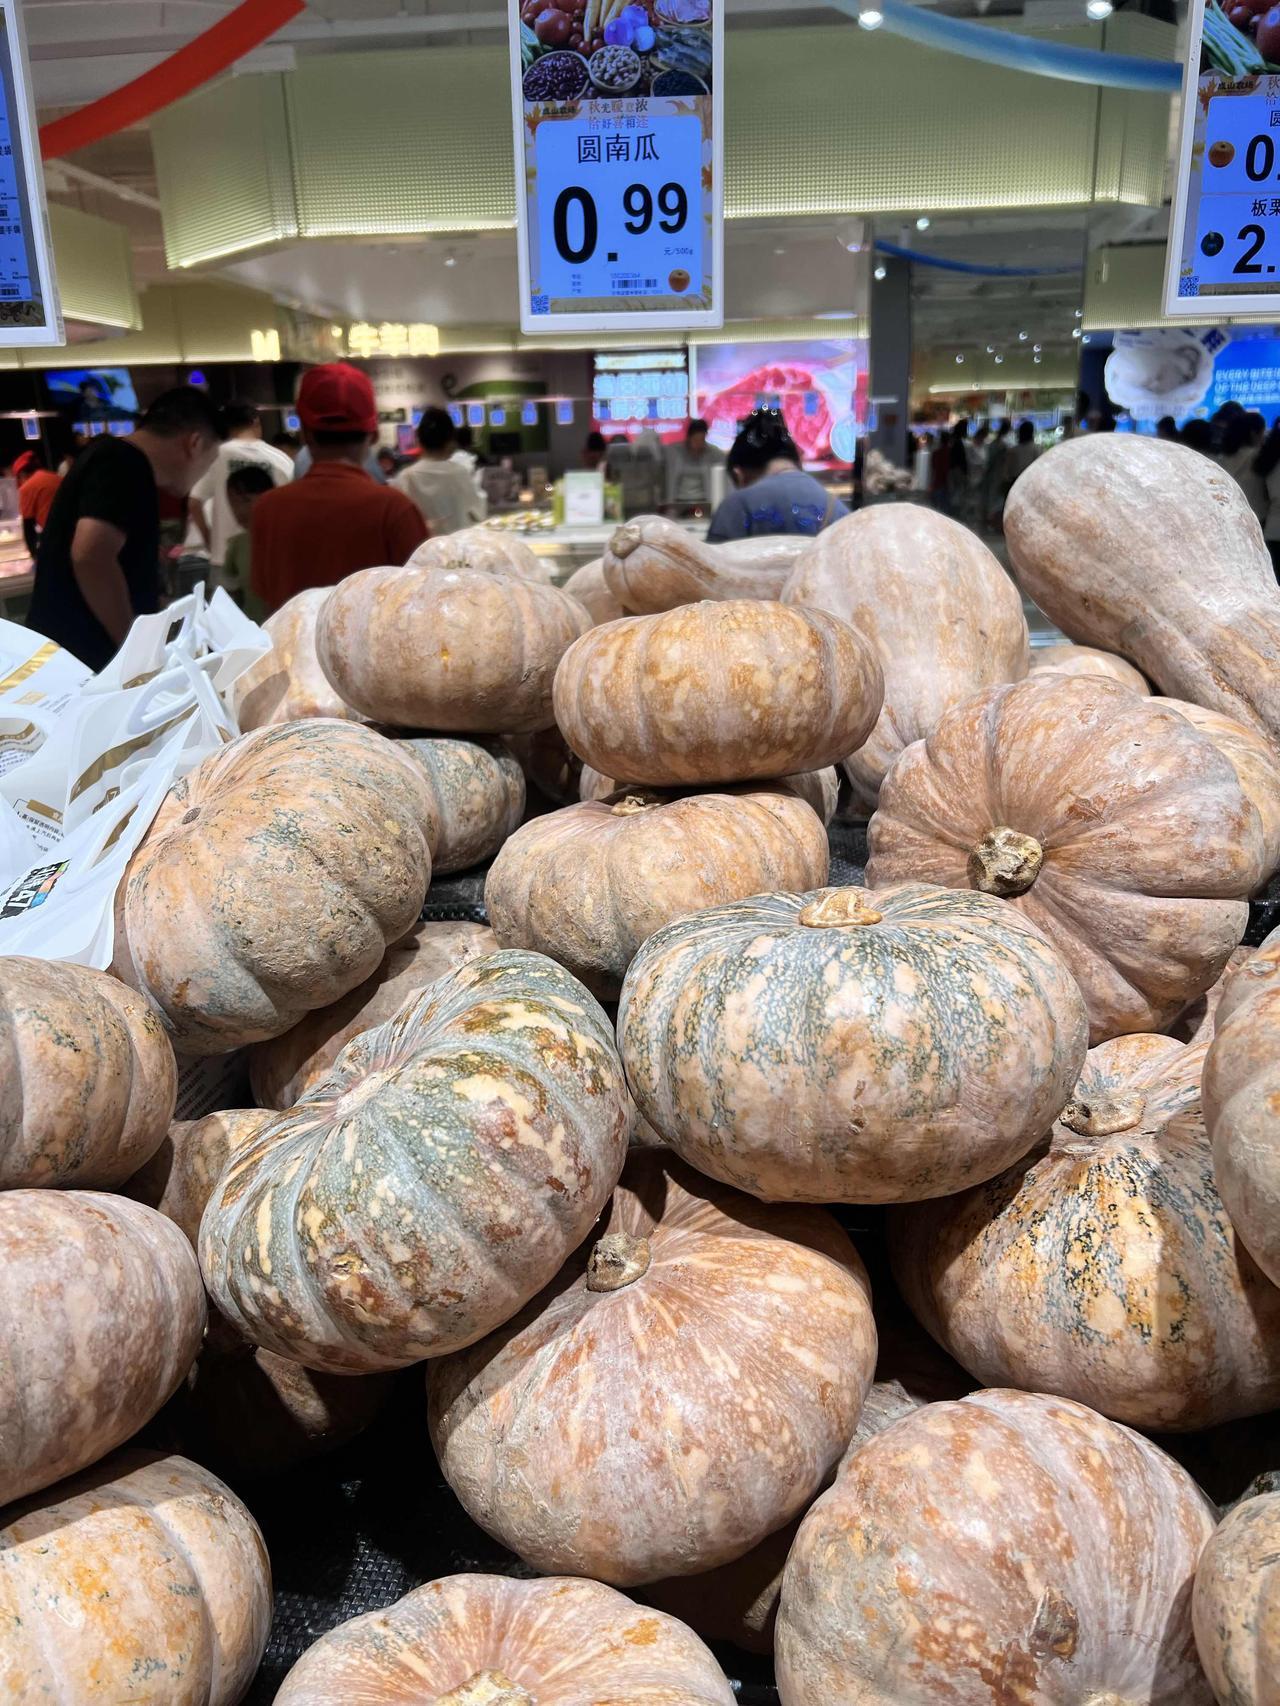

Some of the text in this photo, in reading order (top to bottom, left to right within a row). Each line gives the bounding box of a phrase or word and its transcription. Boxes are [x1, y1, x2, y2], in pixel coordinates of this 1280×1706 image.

[577, 133, 659, 163] 圆南瓜
[553, 182, 688, 264] 0.99
